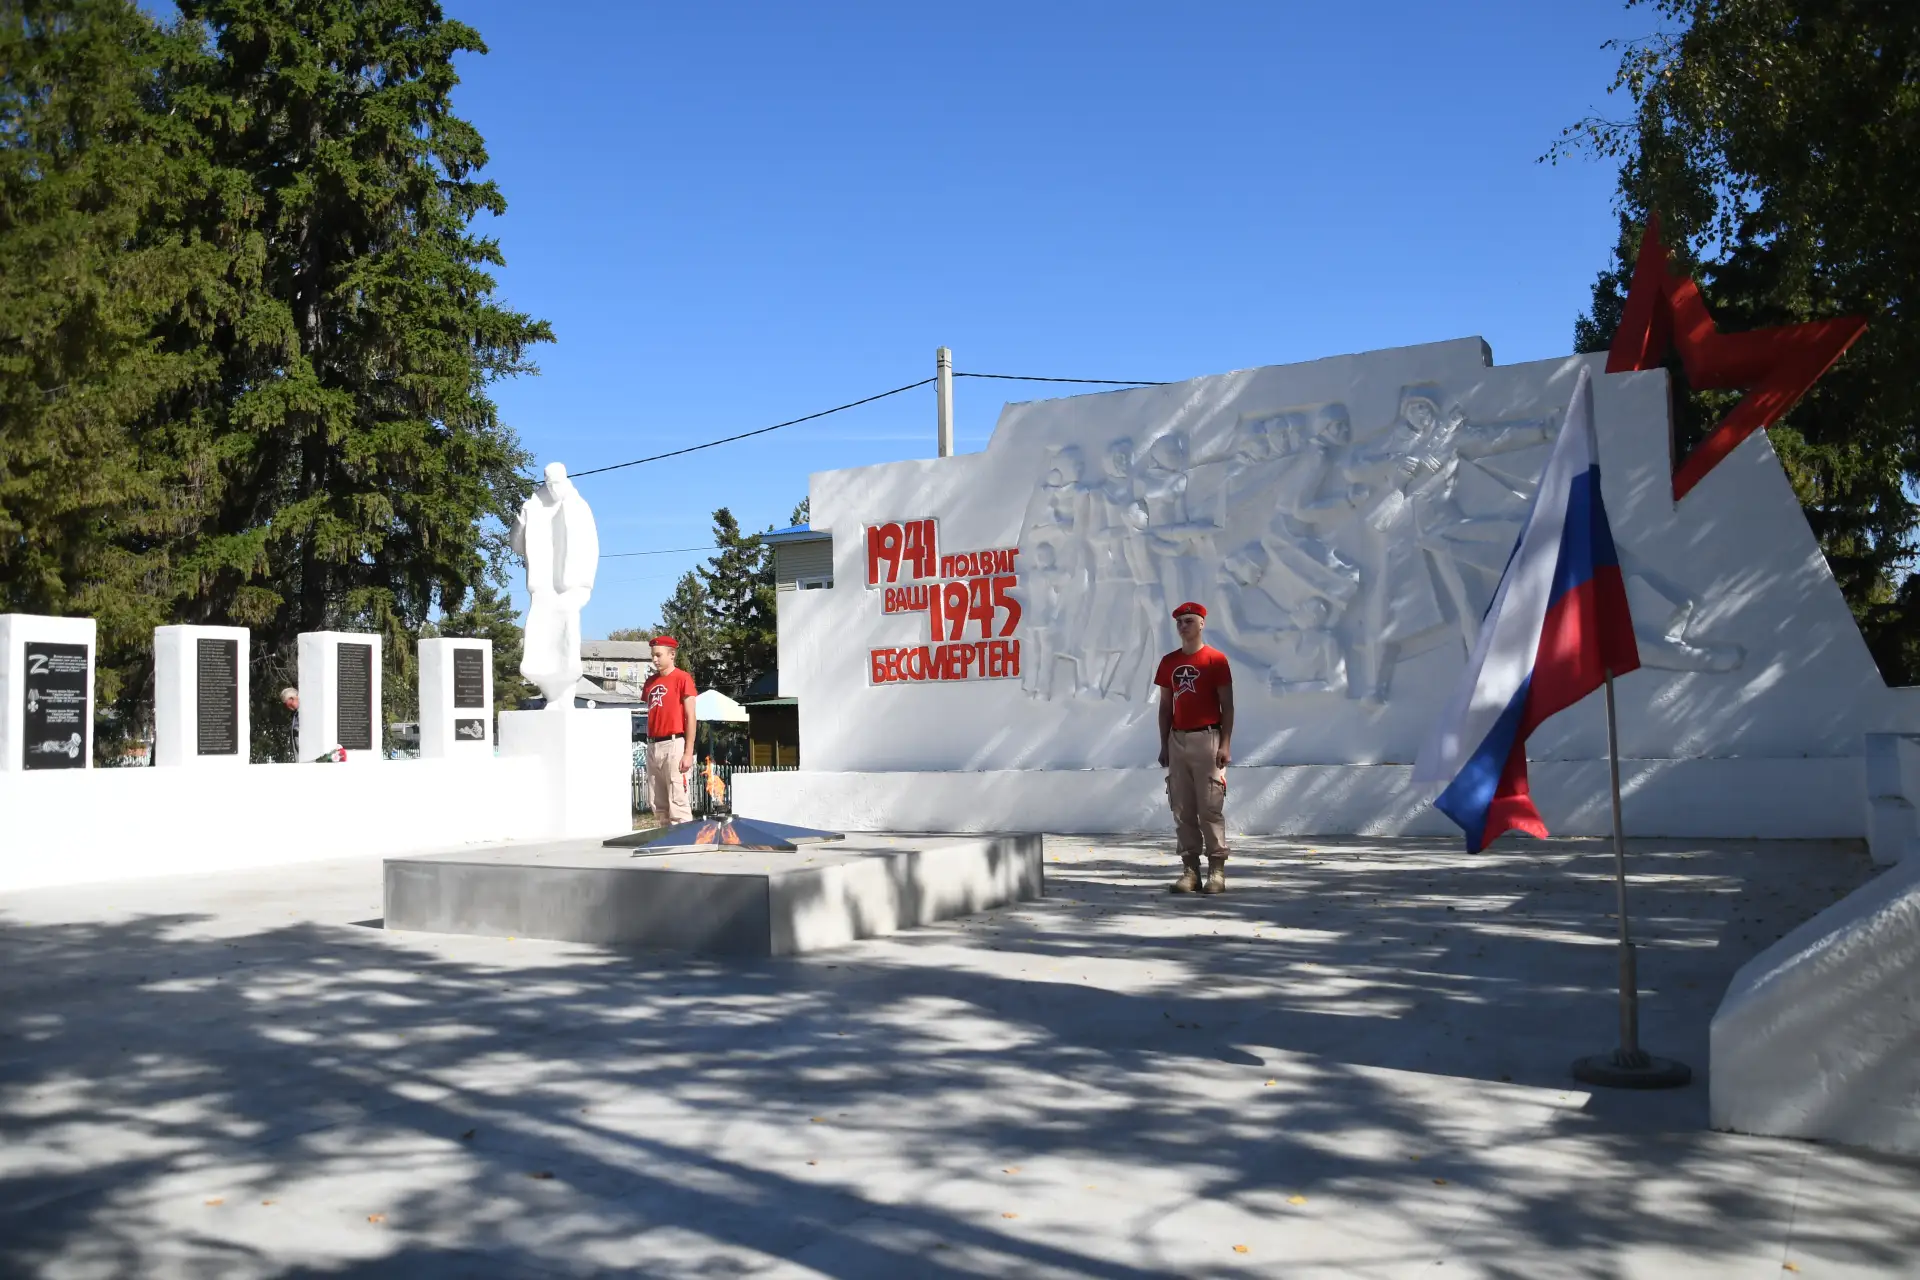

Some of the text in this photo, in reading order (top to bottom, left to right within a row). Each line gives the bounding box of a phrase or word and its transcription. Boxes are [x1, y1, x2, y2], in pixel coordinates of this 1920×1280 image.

[867, 519, 937, 585] 1941
[940, 548, 1019, 579] ПОДВИГ
[885, 584, 928, 613] ВАШ
[929, 576, 1022, 642] 1945
[28, 653, 50, 675] Z
[870, 639, 1020, 683] БЕССМЕРТЕН
